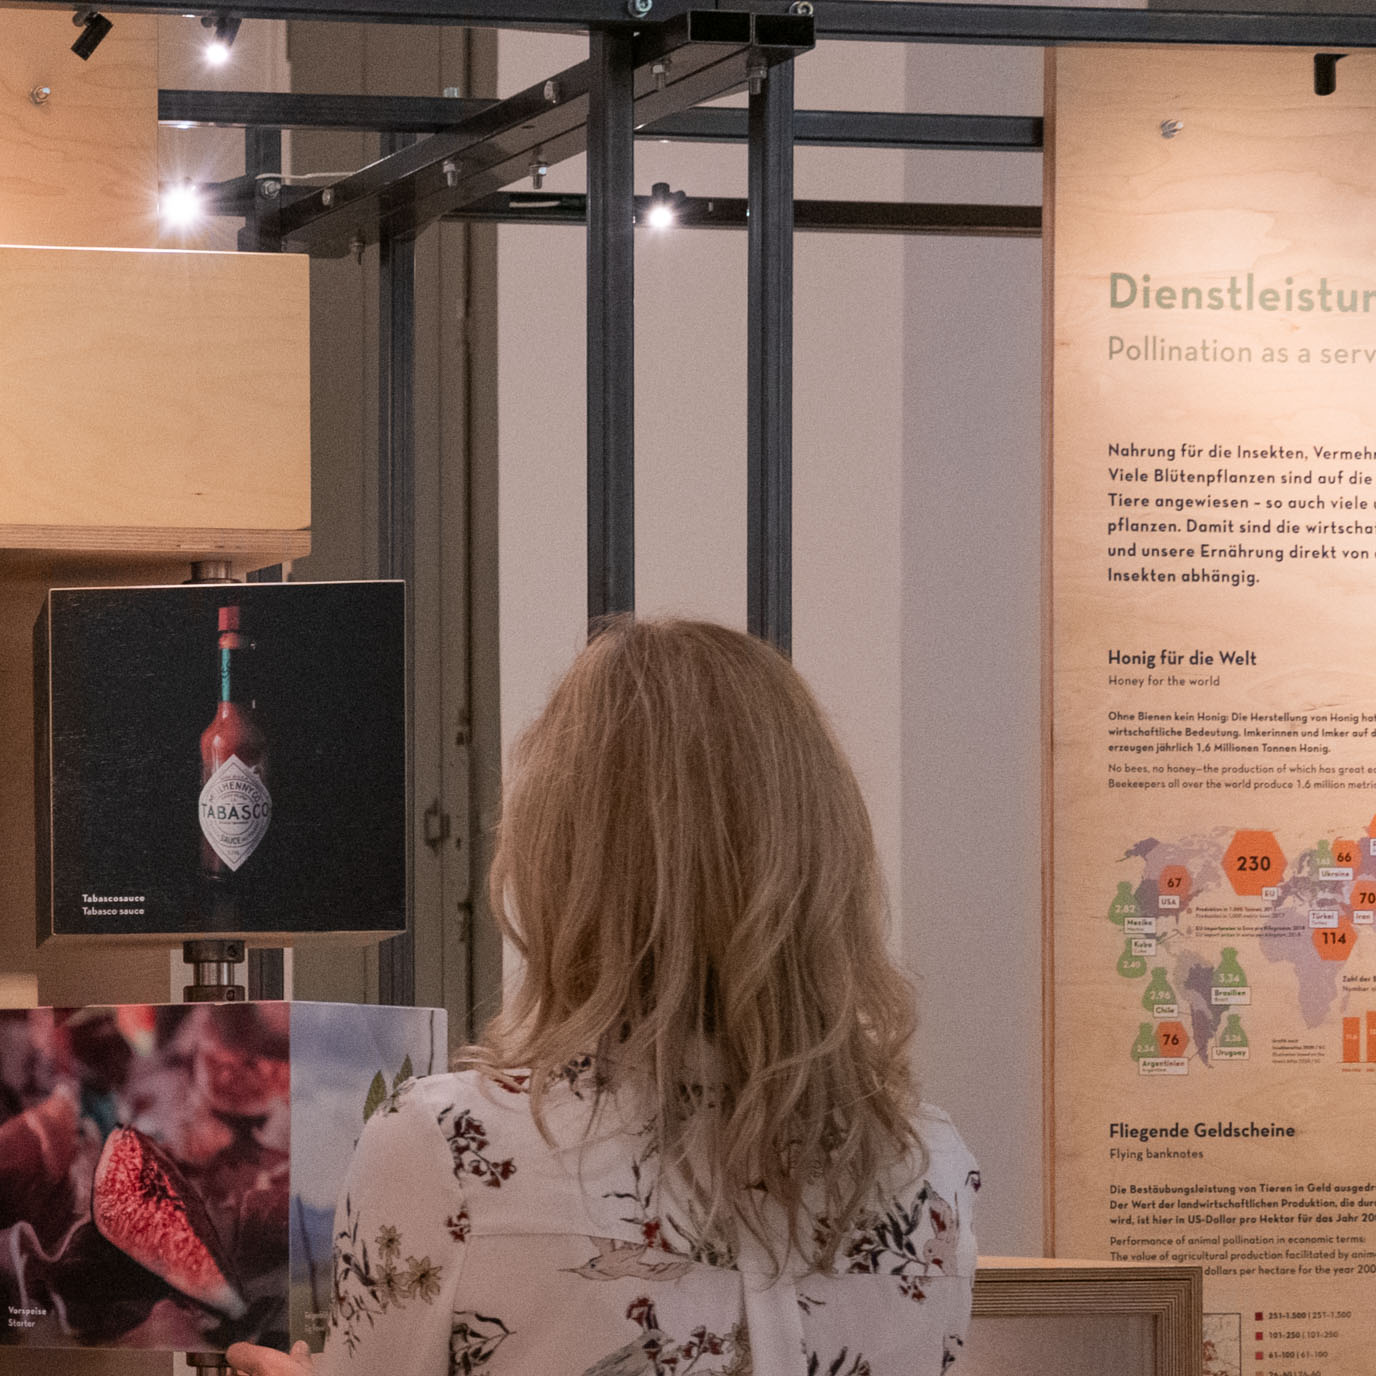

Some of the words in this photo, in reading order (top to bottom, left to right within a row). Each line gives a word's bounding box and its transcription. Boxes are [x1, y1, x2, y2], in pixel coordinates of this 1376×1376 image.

[1109, 336, 1251, 362] Pollination
[1262, 347, 1288, 362] as
[1298, 348, 1310, 363] a
[1109, 443, 1175, 461] Nahrung
[1181, 443, 1203, 457] für
[1209, 444, 1231, 458] die
[1238, 445, 1307, 459] Insekten,
[1109, 468, 1148, 482] Viele
[1154, 468, 1275, 486] Blütenpflanzen
[1281, 471, 1312, 484] sind
[1318, 470, 1343, 484] auf
[1349, 471, 1372, 485] die
[1107, 493, 1150, 507] Tiere
[1154, 495, 1249, 511] angewiesen
[1265, 499, 1284, 509] so
[1287, 495, 1325, 509] auch
[1330, 496, 1368, 509] viele
[1107, 517, 1181, 535] pflanzen.
[1186, 519, 1234, 533] Damit
[1239, 520, 1272, 534] sind
[1276, 520, 1301, 533] die
[1107, 543, 1137, 556] und
[1141, 547, 1196, 558] unsere
[1200, 544, 1284, 562] Ernährung
[1288, 545, 1337, 559] direkt
[1341, 550, 1370, 560] von
[1107, 568, 1176, 582] Insekten
[1181, 568, 1260, 587] abhängig.
[1108, 650, 1156, 669] Honig
[1160, 649, 1185, 665] für
[1188, 650, 1214, 665] die
[1218, 650, 1257, 665] Welt
[1108, 675, 1145, 688] Honey
[1147, 675, 1164, 686] for
[1167, 675, 1186, 686] the
[1188, 676, 1221, 686] world
[1107, 711, 1136, 720] Ohne
[1137, 712, 1173, 721] Bienen
[1173, 712, 1195, 721] kein
[1196, 712, 1229, 724] Honig:
[1231, 712, 1248, 721] Die
[1250, 712, 1308, 726] Herstellung
[1329, 713, 1360, 724] Honig
[1108, 727, 1183, 736] wirtschaftliche
[1184, 727, 1241, 739] Bedeutung.
[1243, 728, 1299, 737] Imkerinnen
[1300, 728, 1320, 737] und
[1321, 728, 1349, 737] Imker
[1351, 727, 1370, 737] auf
[201, 802, 268, 820] TABASCO
[1237, 856, 1271, 872] 230
[1337, 852, 1352, 863] 66
[1167, 877, 1182, 888] 67
[82, 894, 145, 902] Tabascosauce
[1359, 892, 1376, 904] 70
[82, 907, 118, 915] Tabasco
[119, 908, 145, 916] sauce
[1321, 932, 1347, 944] 114
[1162, 1034, 1180, 1046] 76
[1109, 1122, 1190, 1142] Fliegende
[1193, 1122, 1296, 1137] Geldscheine
[1109, 1148, 1144, 1161] Flying
[1145, 1147, 1204, 1158] banknotes
[1109, 1185, 1127, 1194] Die
[1129, 1184, 1237, 1196] Bestäubungsleistung
[1238, 1185, 1257, 1194] von
[1259, 1184, 1293, 1192] Tieren
[1294, 1184, 1305, 1192] in
[1306, 1183, 1332, 1192] Geld
[8, 1306, 47, 1317] Vorspeise
[8, 1318, 36, 1328] Starter
